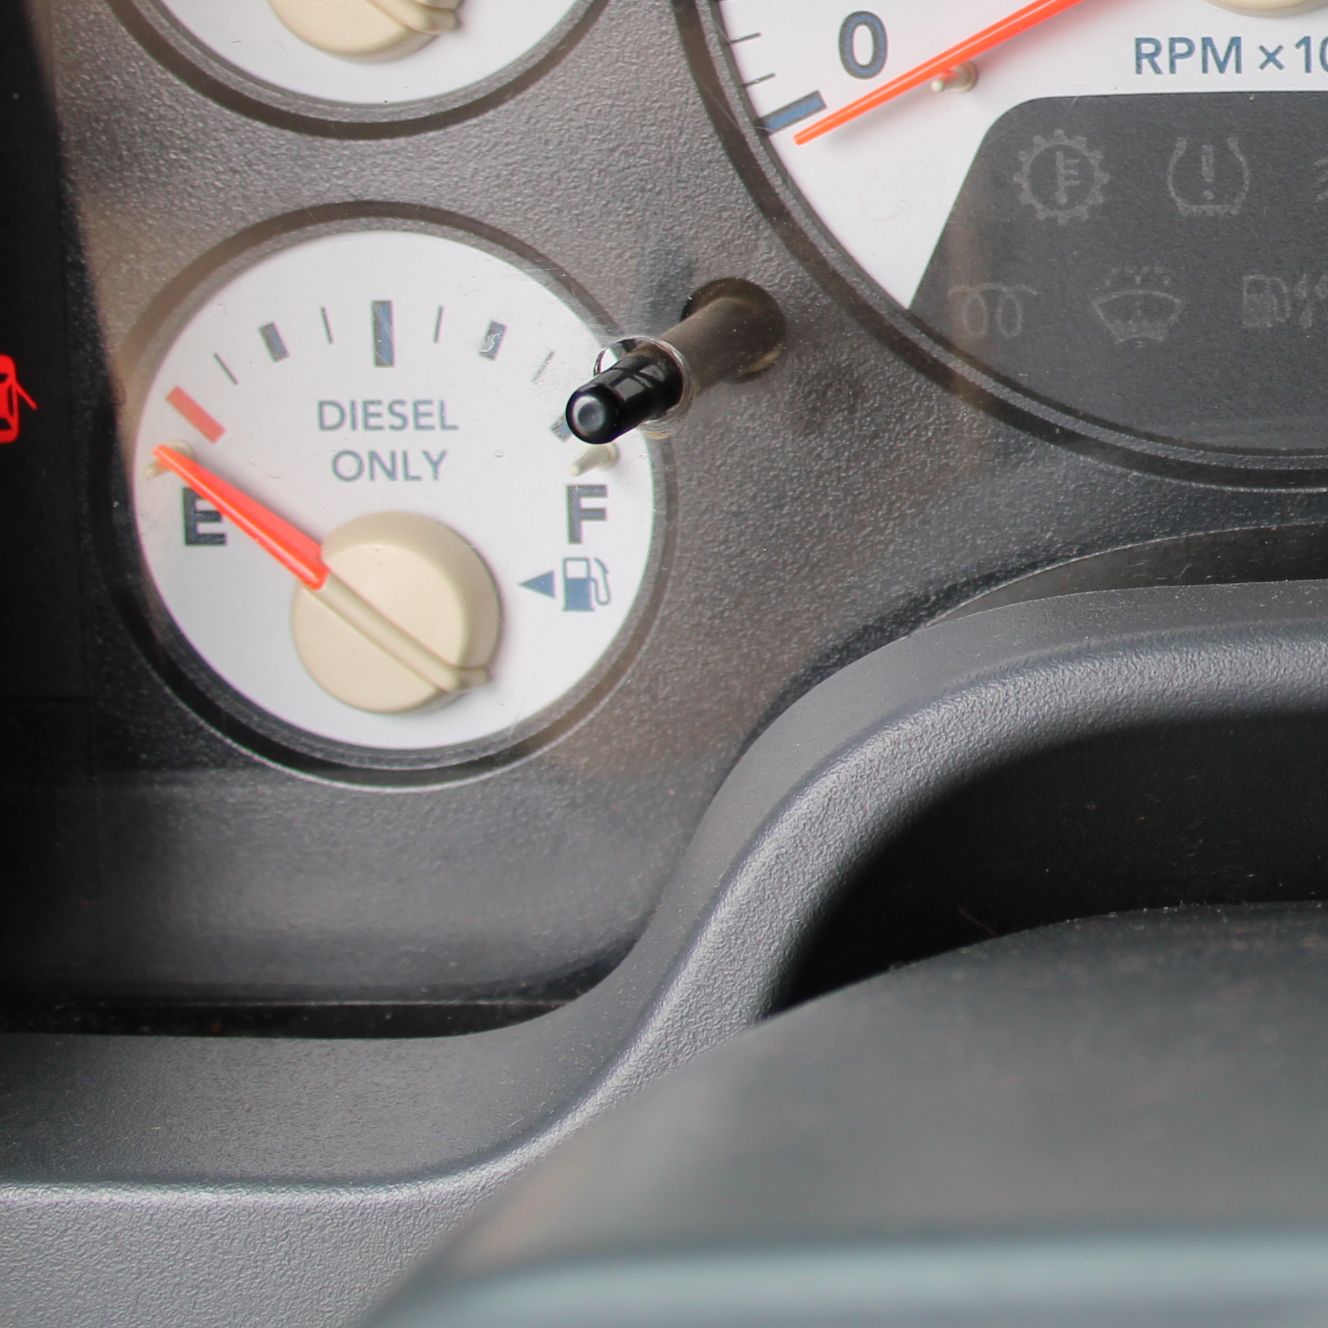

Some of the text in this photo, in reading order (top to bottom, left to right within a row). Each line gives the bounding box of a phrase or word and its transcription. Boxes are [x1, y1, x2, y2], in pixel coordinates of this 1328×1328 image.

[838, 10, 889, 80] 0
[1134, 35, 1243, 75] RPM
[316, 399, 458, 432] DIESEL
[331, 449, 448, 482] ONLY
[181, 487, 227, 547] E
[565, 484, 609, 545] F
